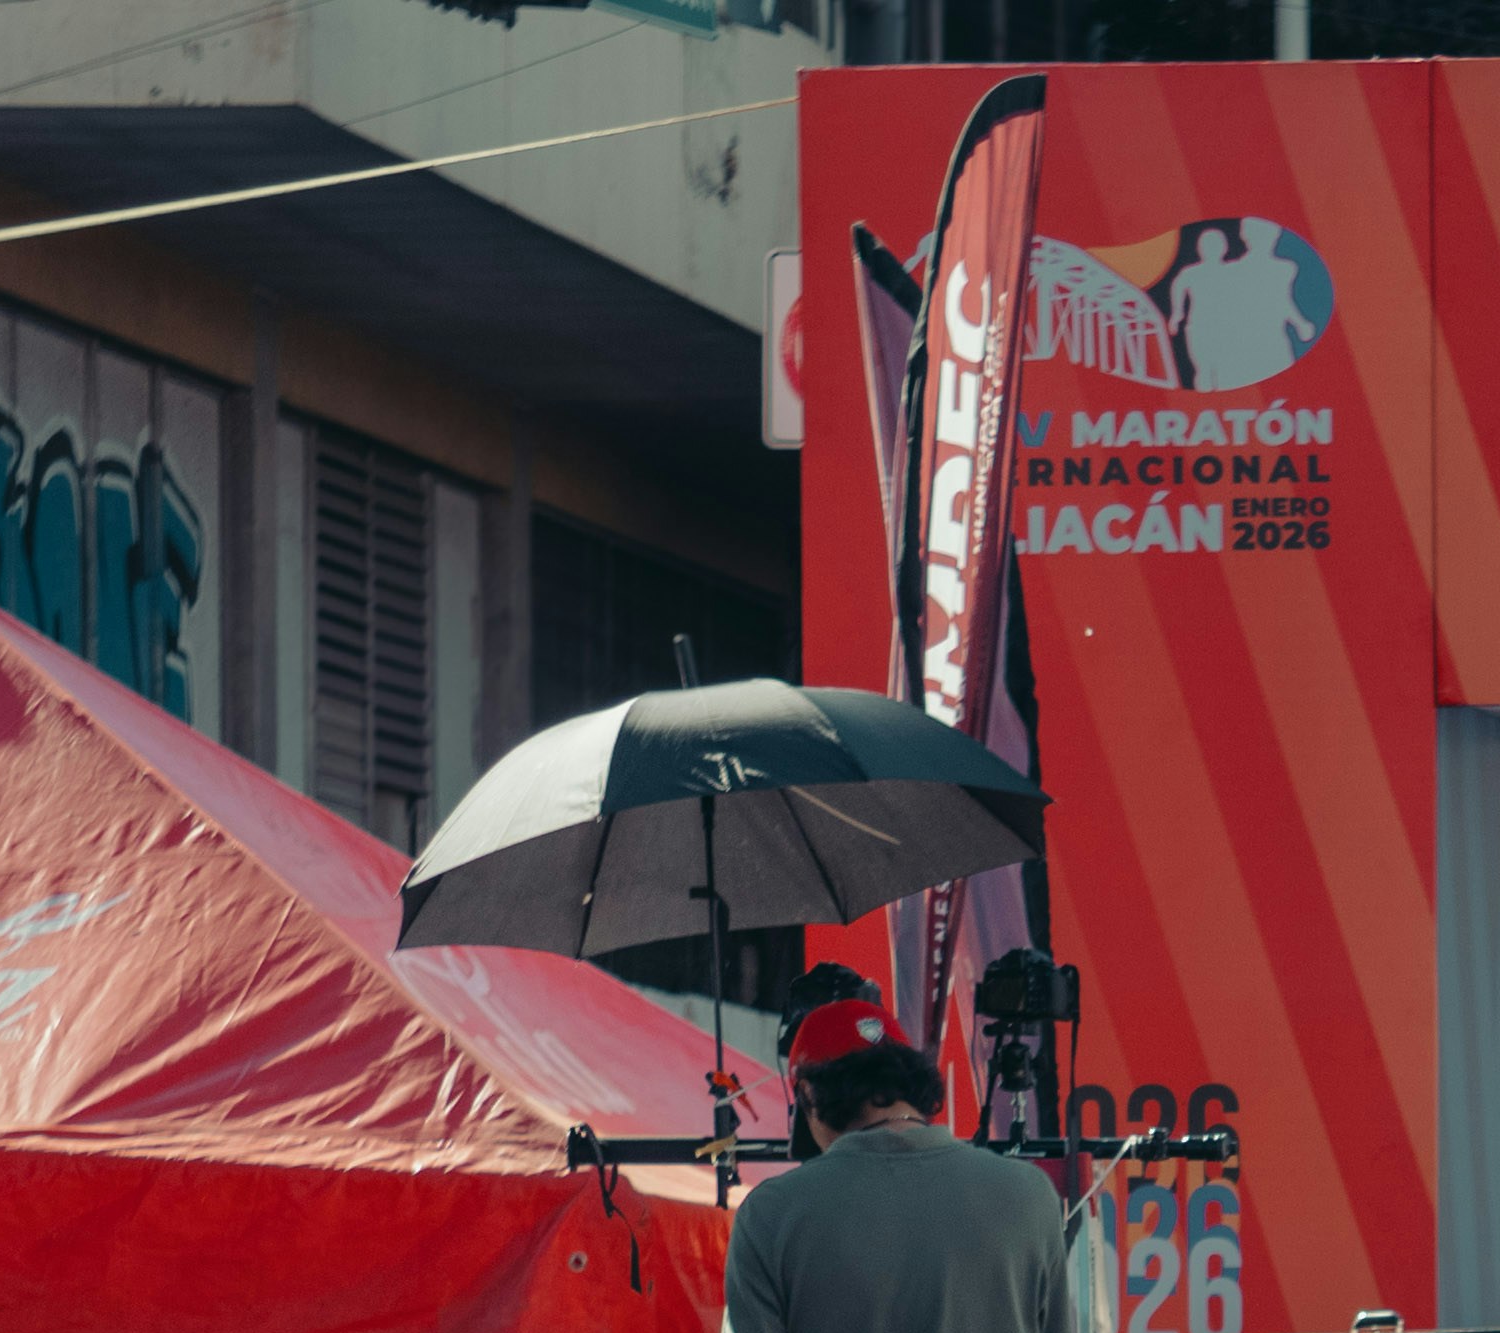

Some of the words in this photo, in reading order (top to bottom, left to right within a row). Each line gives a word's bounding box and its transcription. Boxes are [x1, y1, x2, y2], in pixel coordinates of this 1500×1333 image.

[1071, 399, 1333, 449] MARATÓN
[1232, 498, 1330, 518] ENERO
[1232, 520, 1331, 551] 2026
